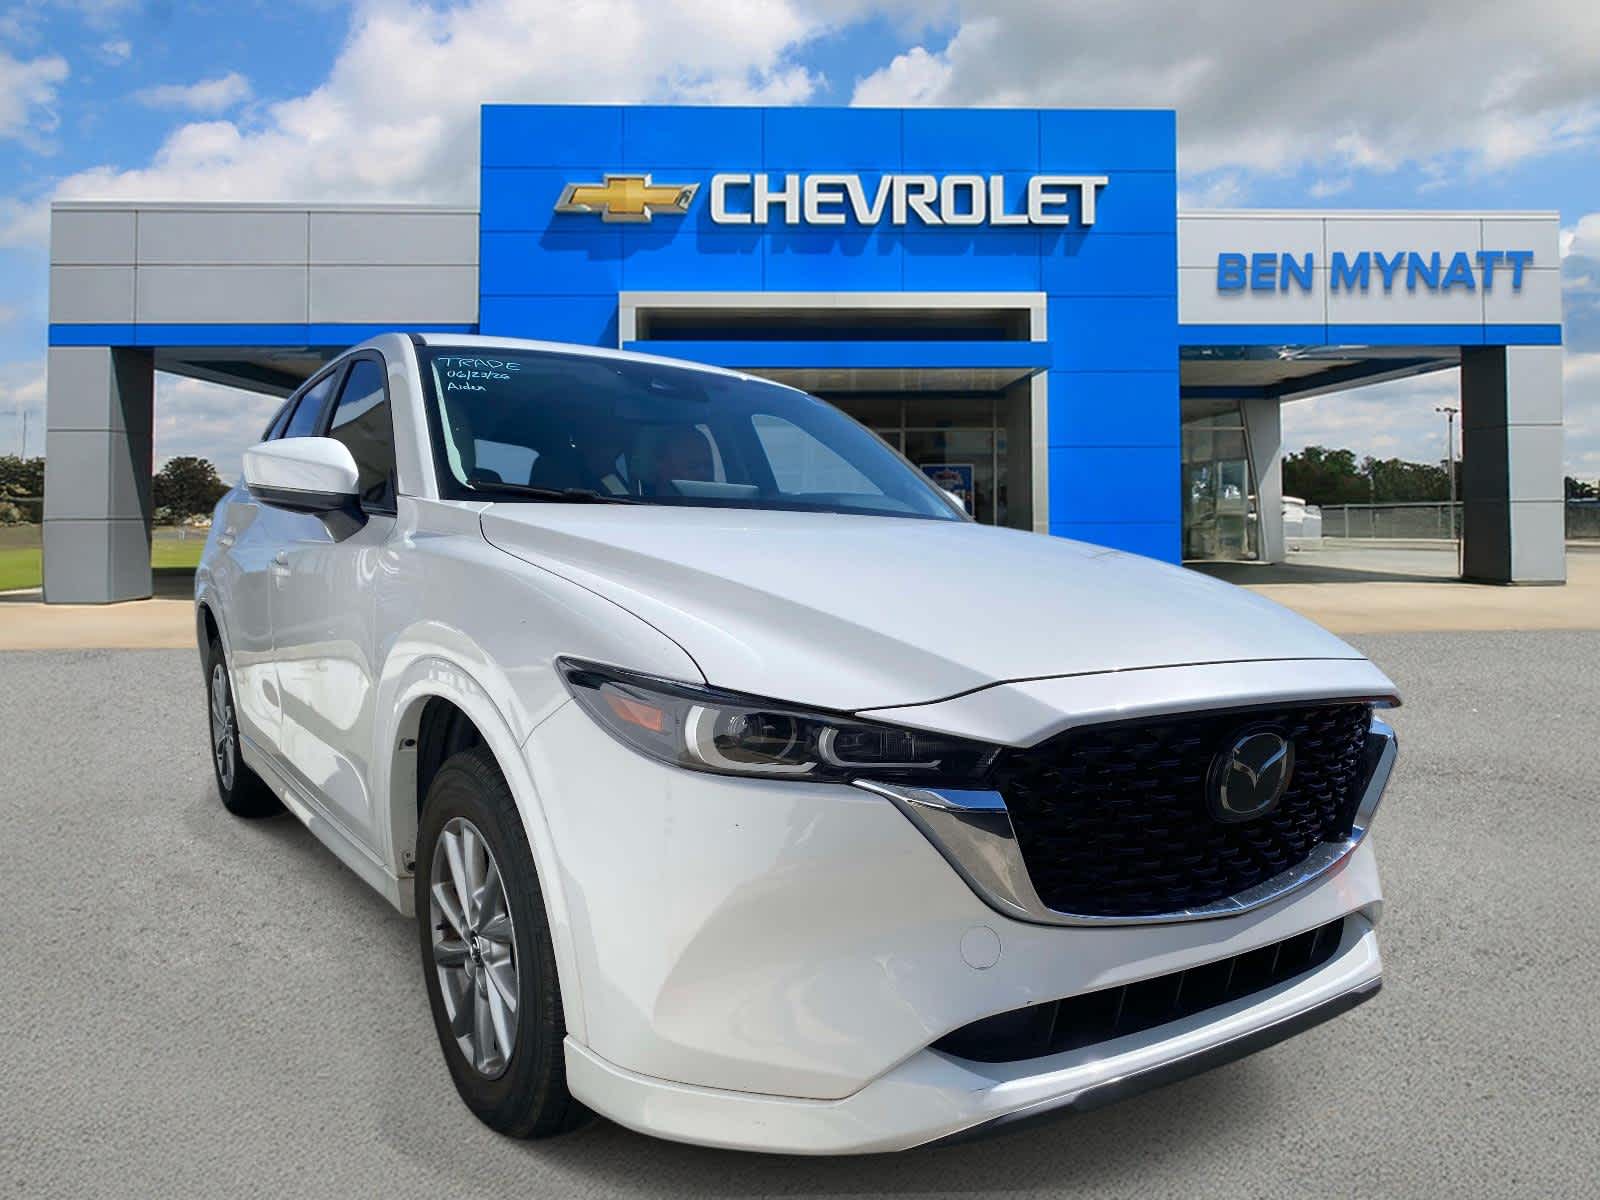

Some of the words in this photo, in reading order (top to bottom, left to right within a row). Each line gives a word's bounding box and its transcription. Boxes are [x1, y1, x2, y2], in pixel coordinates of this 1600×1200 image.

[710, 173, 1109, 226] CHEVROLET
[1216, 252, 1314, 291] BEN
[1330, 250, 1534, 291] MYNATT
[438, 356, 521, 371] TRADE
